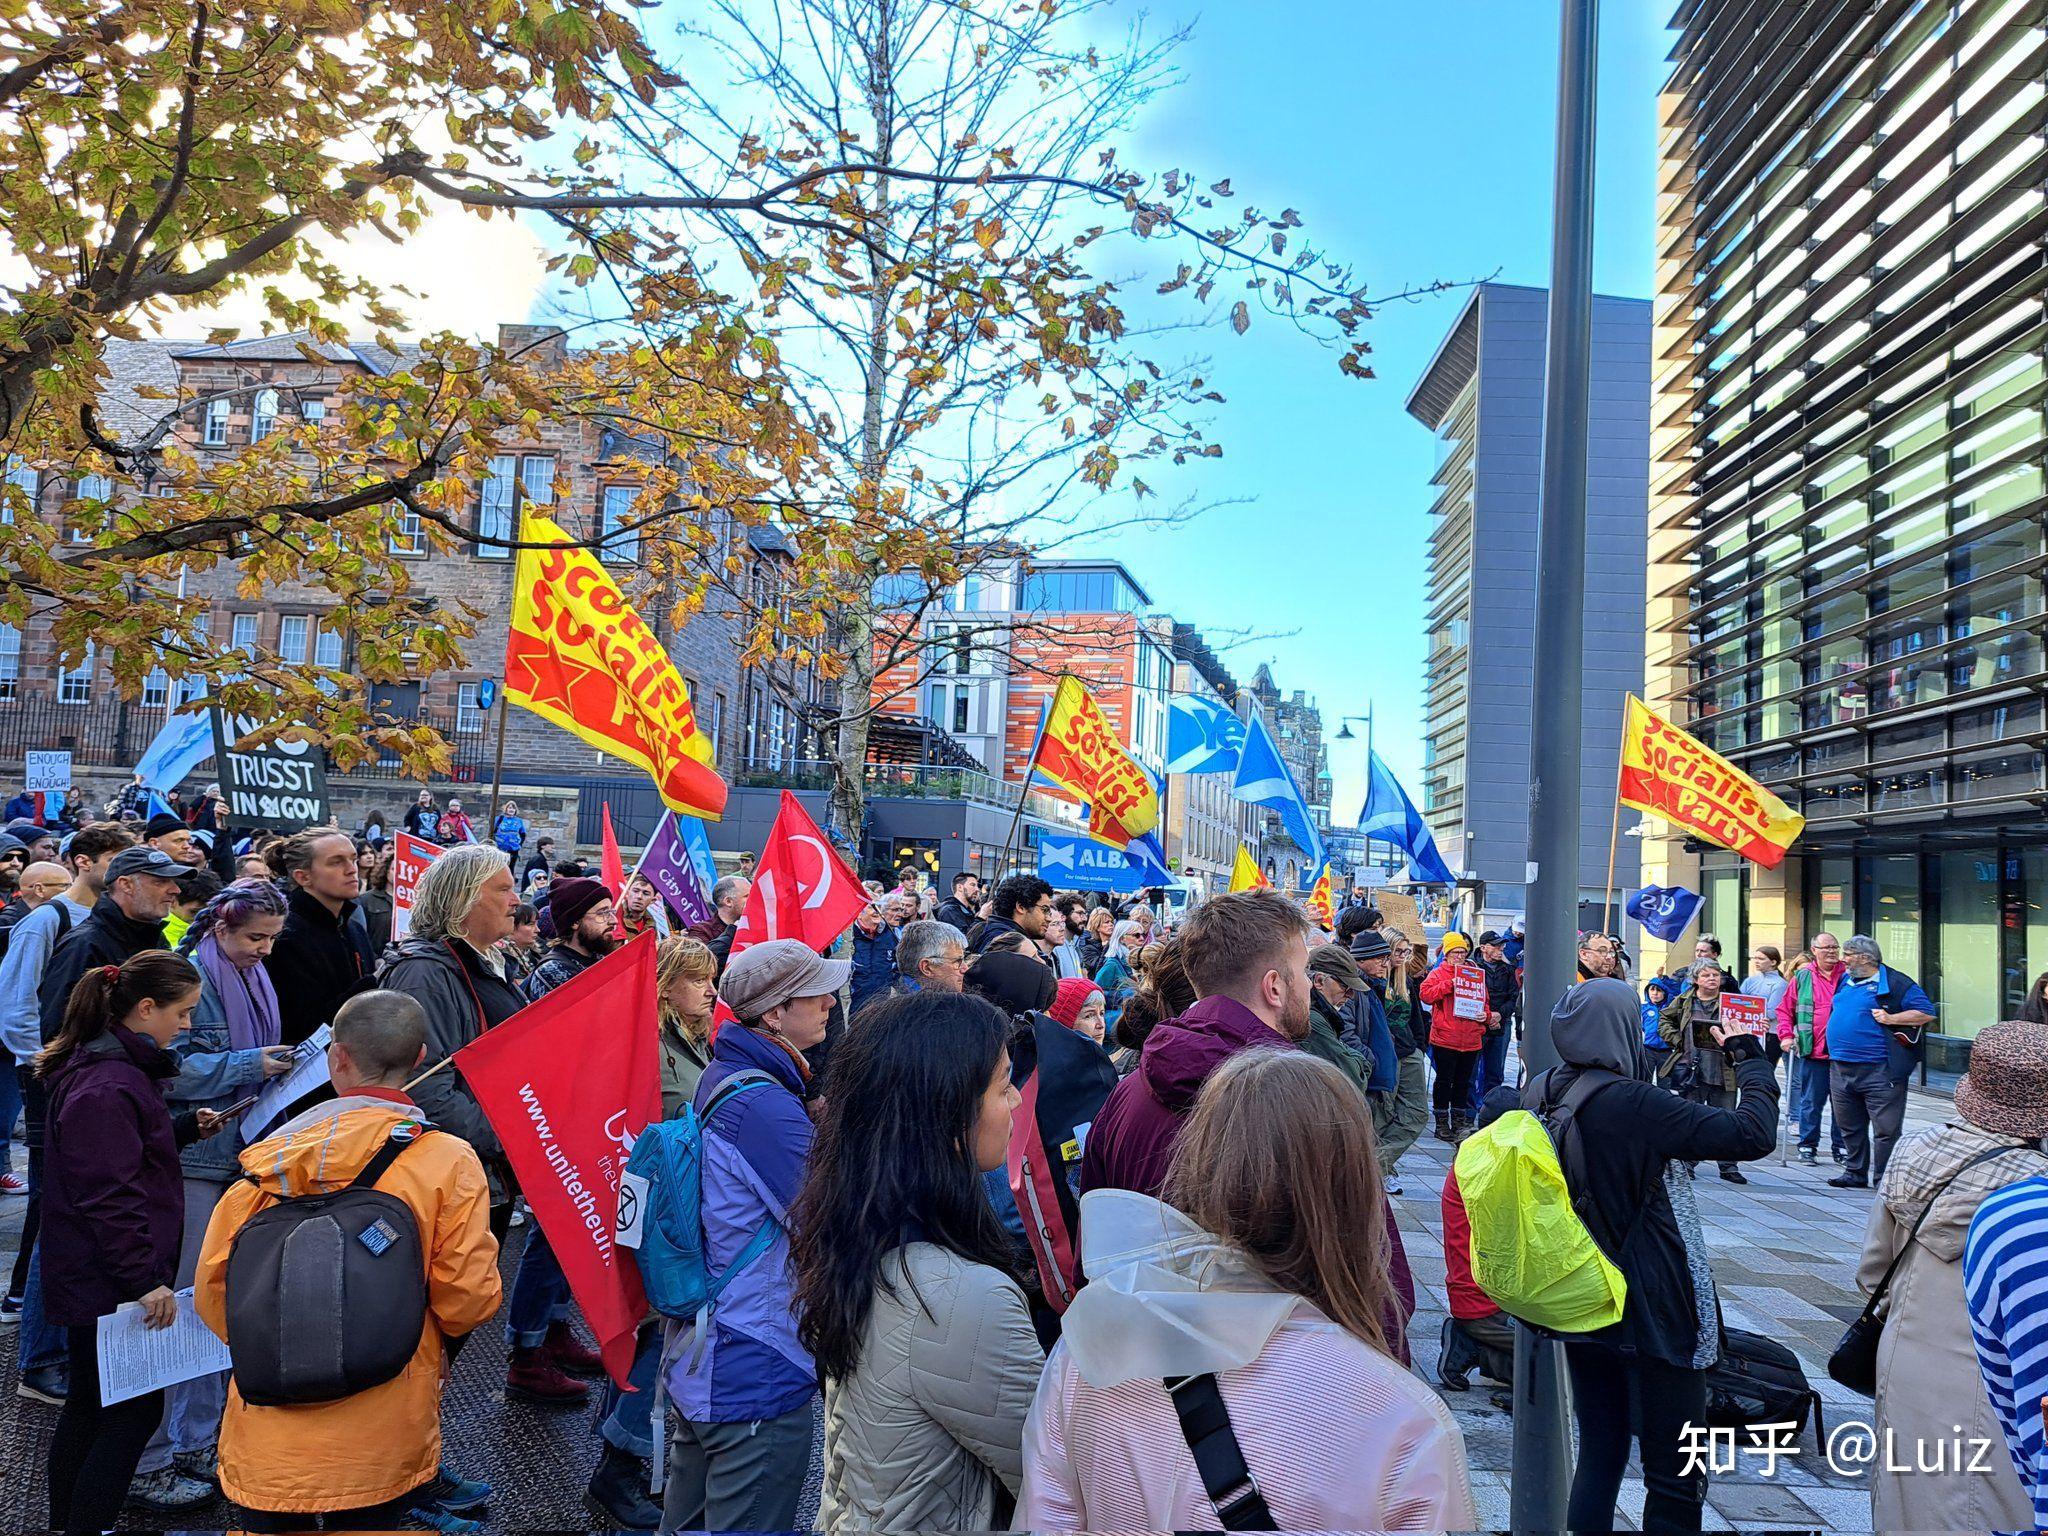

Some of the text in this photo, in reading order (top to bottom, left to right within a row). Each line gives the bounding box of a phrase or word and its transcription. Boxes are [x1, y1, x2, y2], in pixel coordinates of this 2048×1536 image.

[1192, 708, 1247, 750] Ye
[29, 752, 69, 765] ENOUGH
[29, 777, 70, 789] ENOUGH!
[42, 766, 56, 778] IS
[226, 752, 315, 792] TRUSST
[232, 791, 258, 816] IN
[280, 796, 320, 821] GOV
[1677, 789, 1754, 850] Party
[398, 860, 419, 882] It'
[659, 869, 681, 896] City
[681, 897, 693, 912] of
[1722, 1007, 1742, 1020] It's
